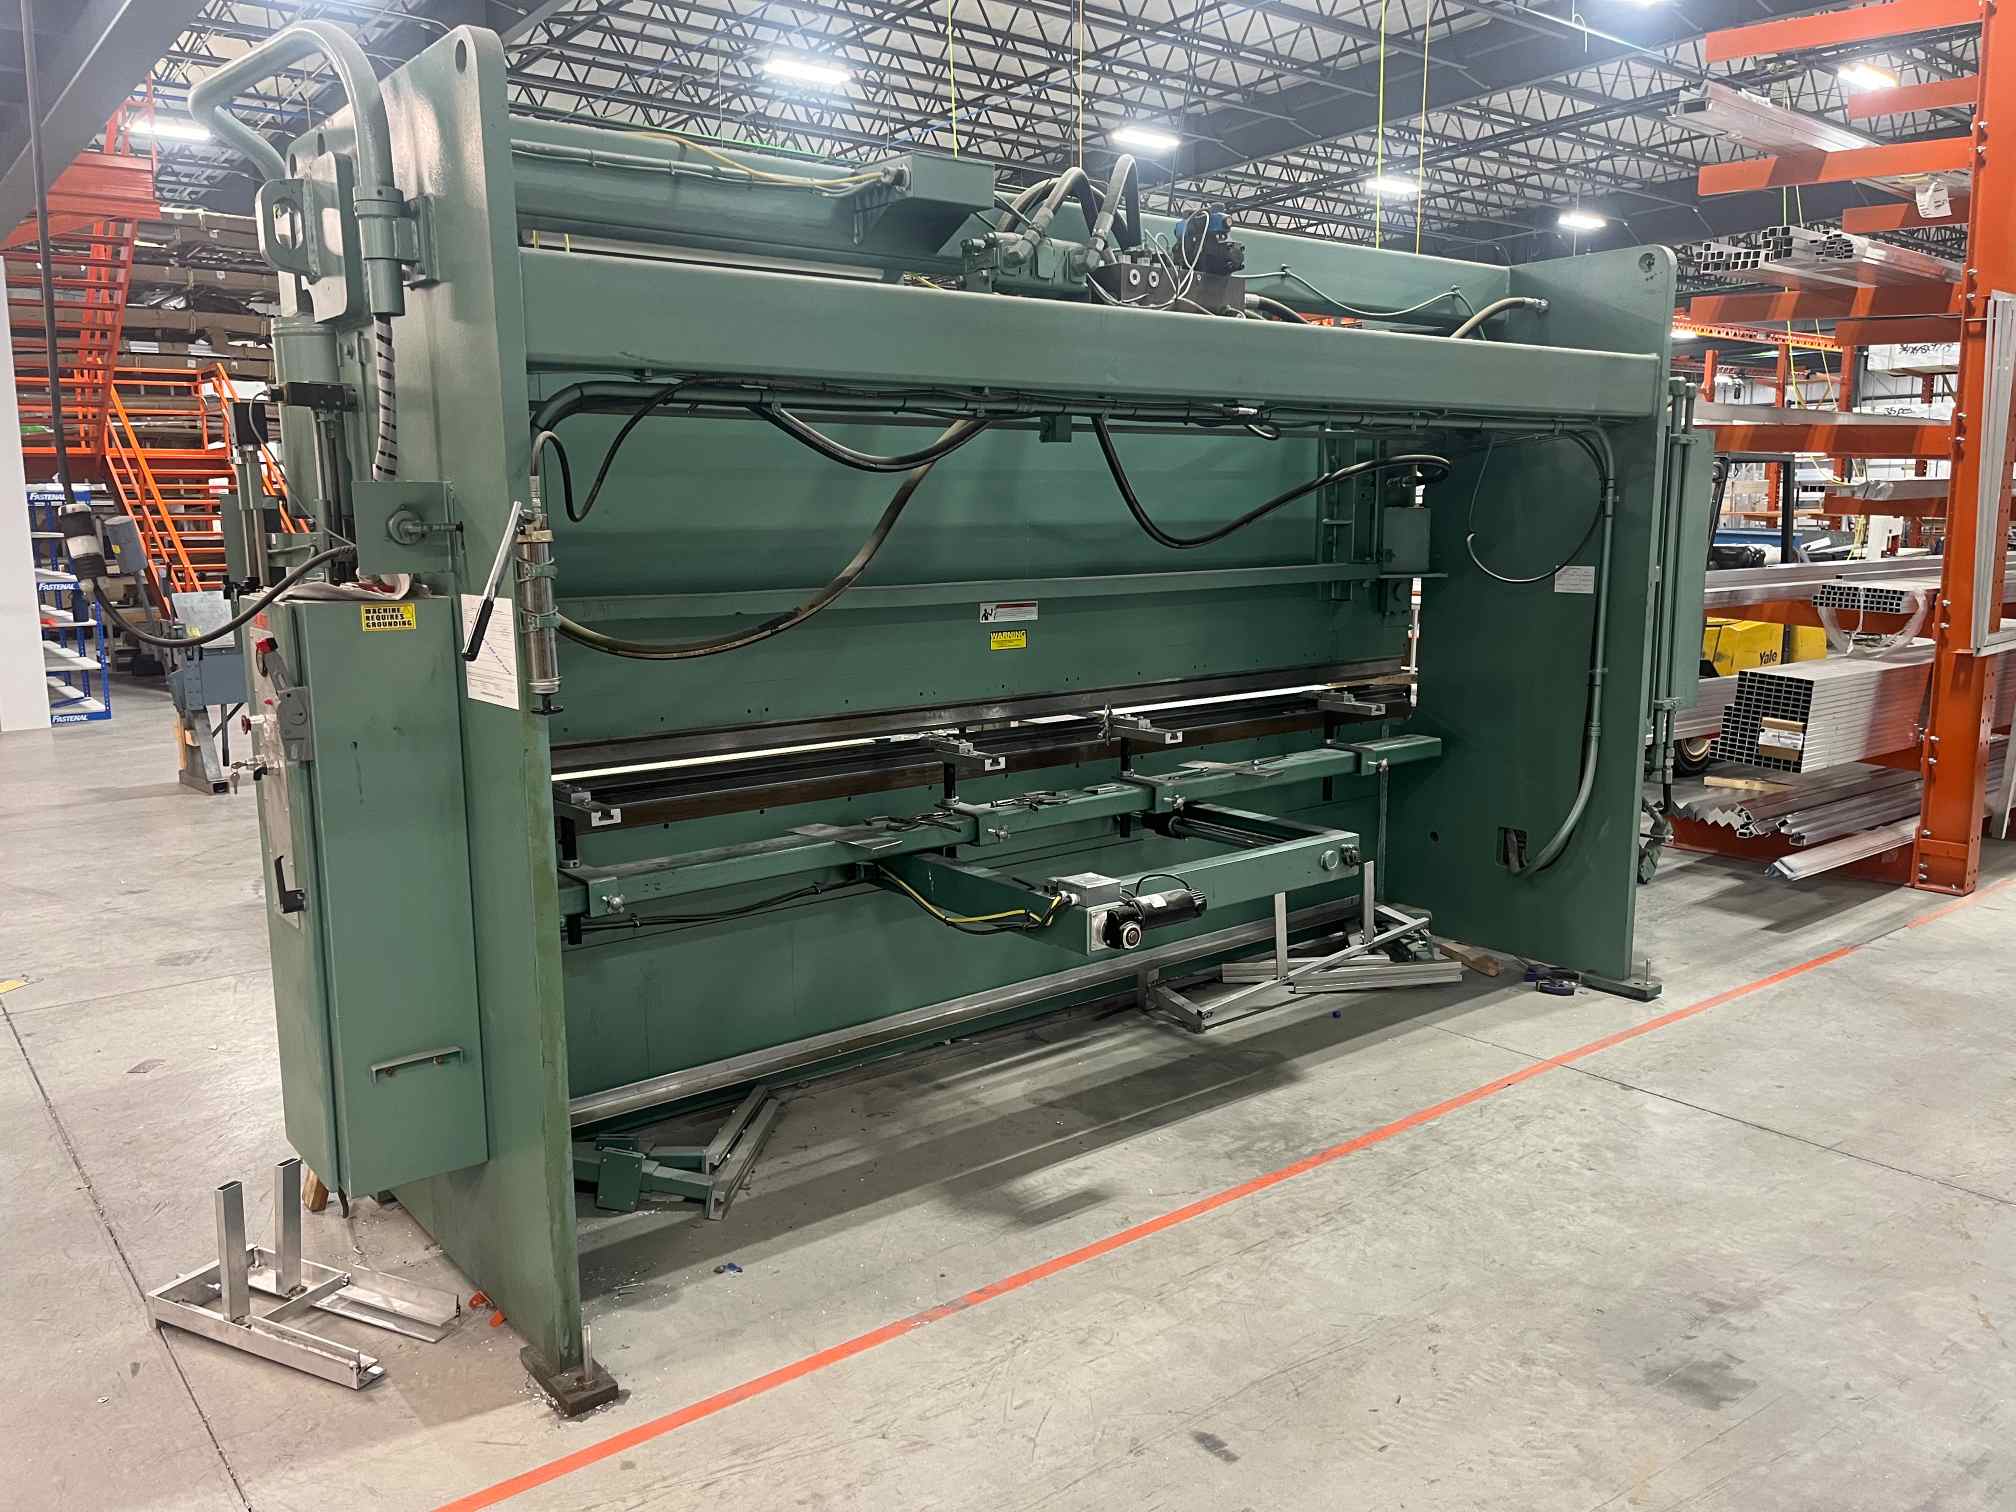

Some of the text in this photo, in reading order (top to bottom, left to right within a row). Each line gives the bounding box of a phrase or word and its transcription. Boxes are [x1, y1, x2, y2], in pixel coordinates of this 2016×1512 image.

[38, 582, 74, 591] FASTENAL
[365, 607, 401, 615] MACHINE
[365, 613, 405, 622] REQUIRES
[366, 620, 412, 628] GROUNDING
[991, 630, 1026, 641] WARNING
[1760, 649, 1778, 666] Yale
[52, 714, 88, 723] FASTENAL
